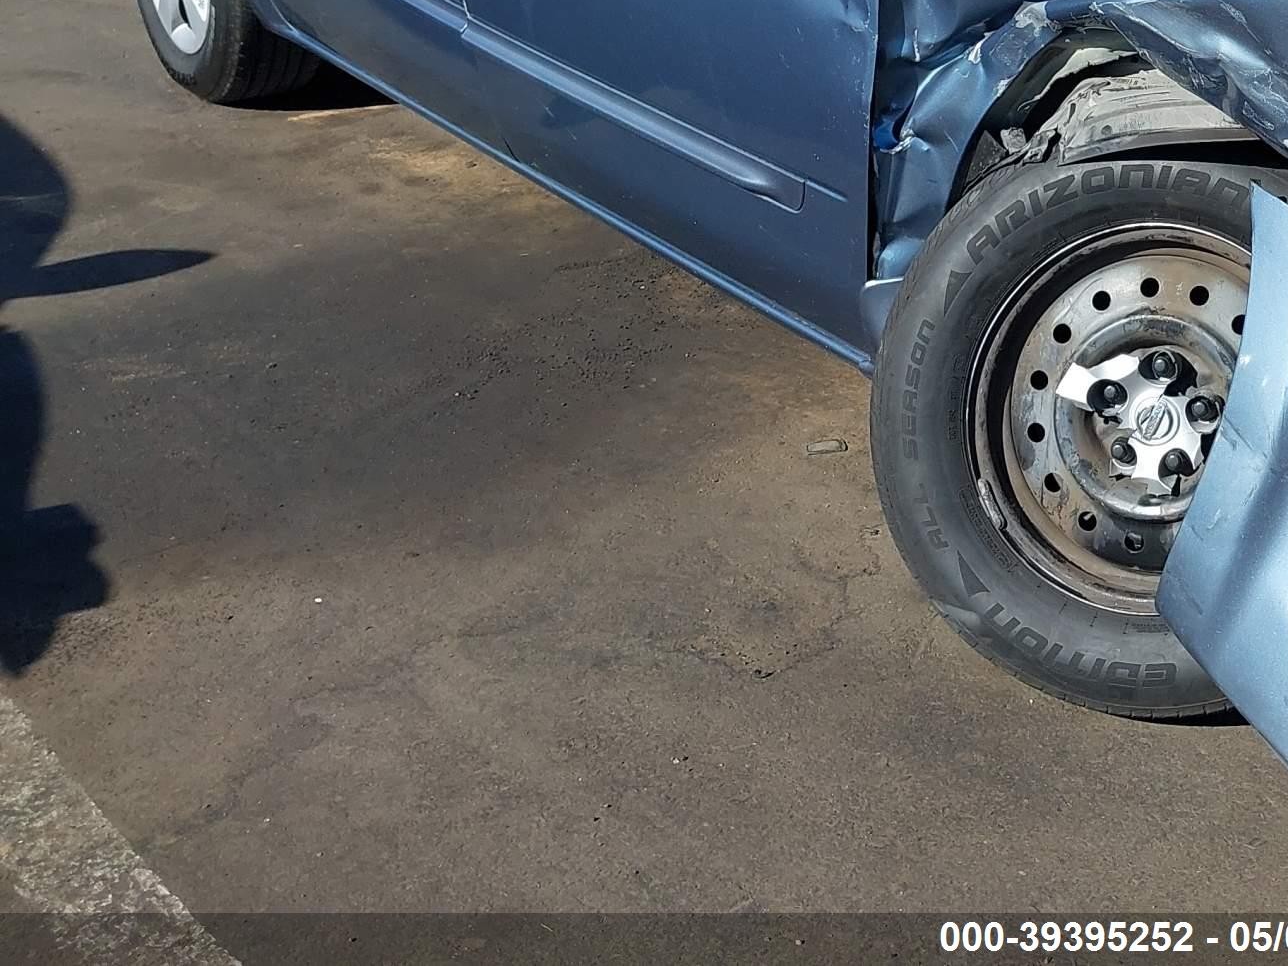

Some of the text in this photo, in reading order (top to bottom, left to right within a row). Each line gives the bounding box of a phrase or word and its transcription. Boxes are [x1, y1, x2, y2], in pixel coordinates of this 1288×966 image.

[965, 160, 1250, 266] ARIZONIAN
[903, 316, 950, 551] ALL SEASON
[985, 602, 1178, 689] EDITION
